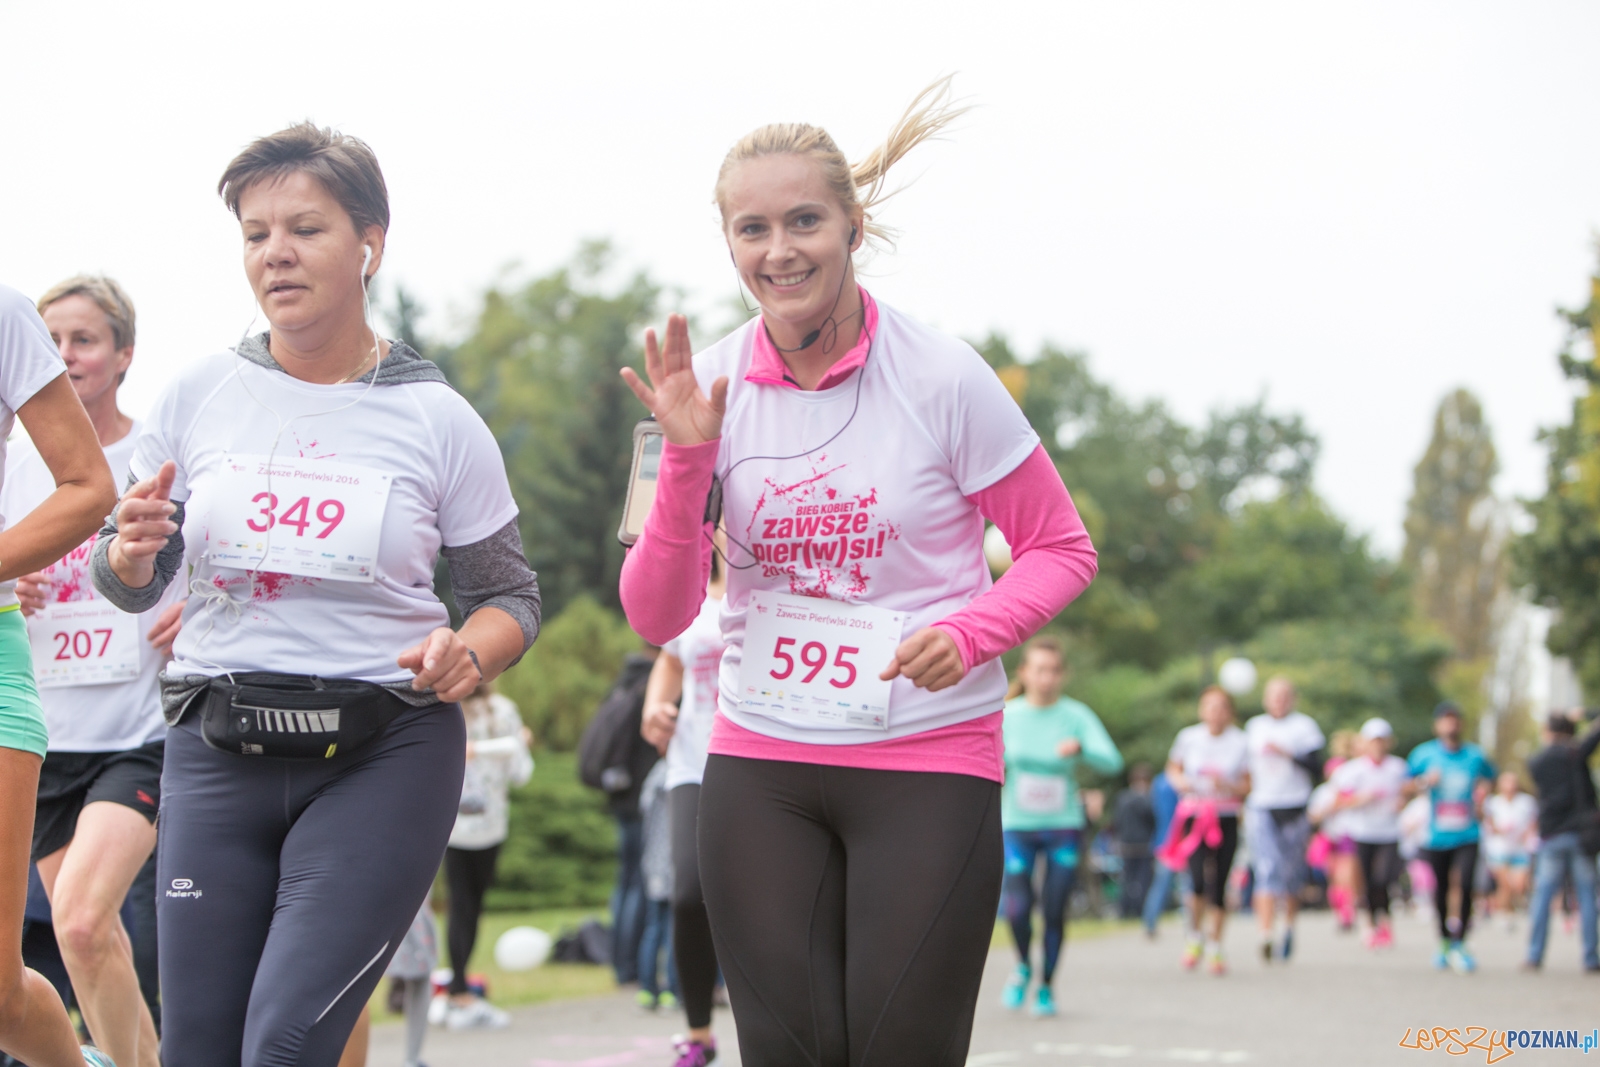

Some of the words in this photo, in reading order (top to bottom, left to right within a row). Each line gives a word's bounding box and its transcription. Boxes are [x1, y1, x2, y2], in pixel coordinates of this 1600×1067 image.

[257, 466, 292, 478] Zawsze
[293, 469, 334, 482] Pier(w)si
[335, 474, 360, 486] 2016
[246, 491, 345, 540] 349
[795, 504, 819, 516] BIEG
[820, 501, 855, 515] KOBIET
[762, 511, 869, 539] zawsze
[752, 530, 886, 569] pier(w)si!
[762, 563, 797, 578] 2016
[776, 607, 808, 621] Zawsze
[808, 612, 847, 627] Pier(w)si
[848, 618, 874, 631] 2016
[53, 627, 114, 661] 207
[769, 636, 860, 689] 595
